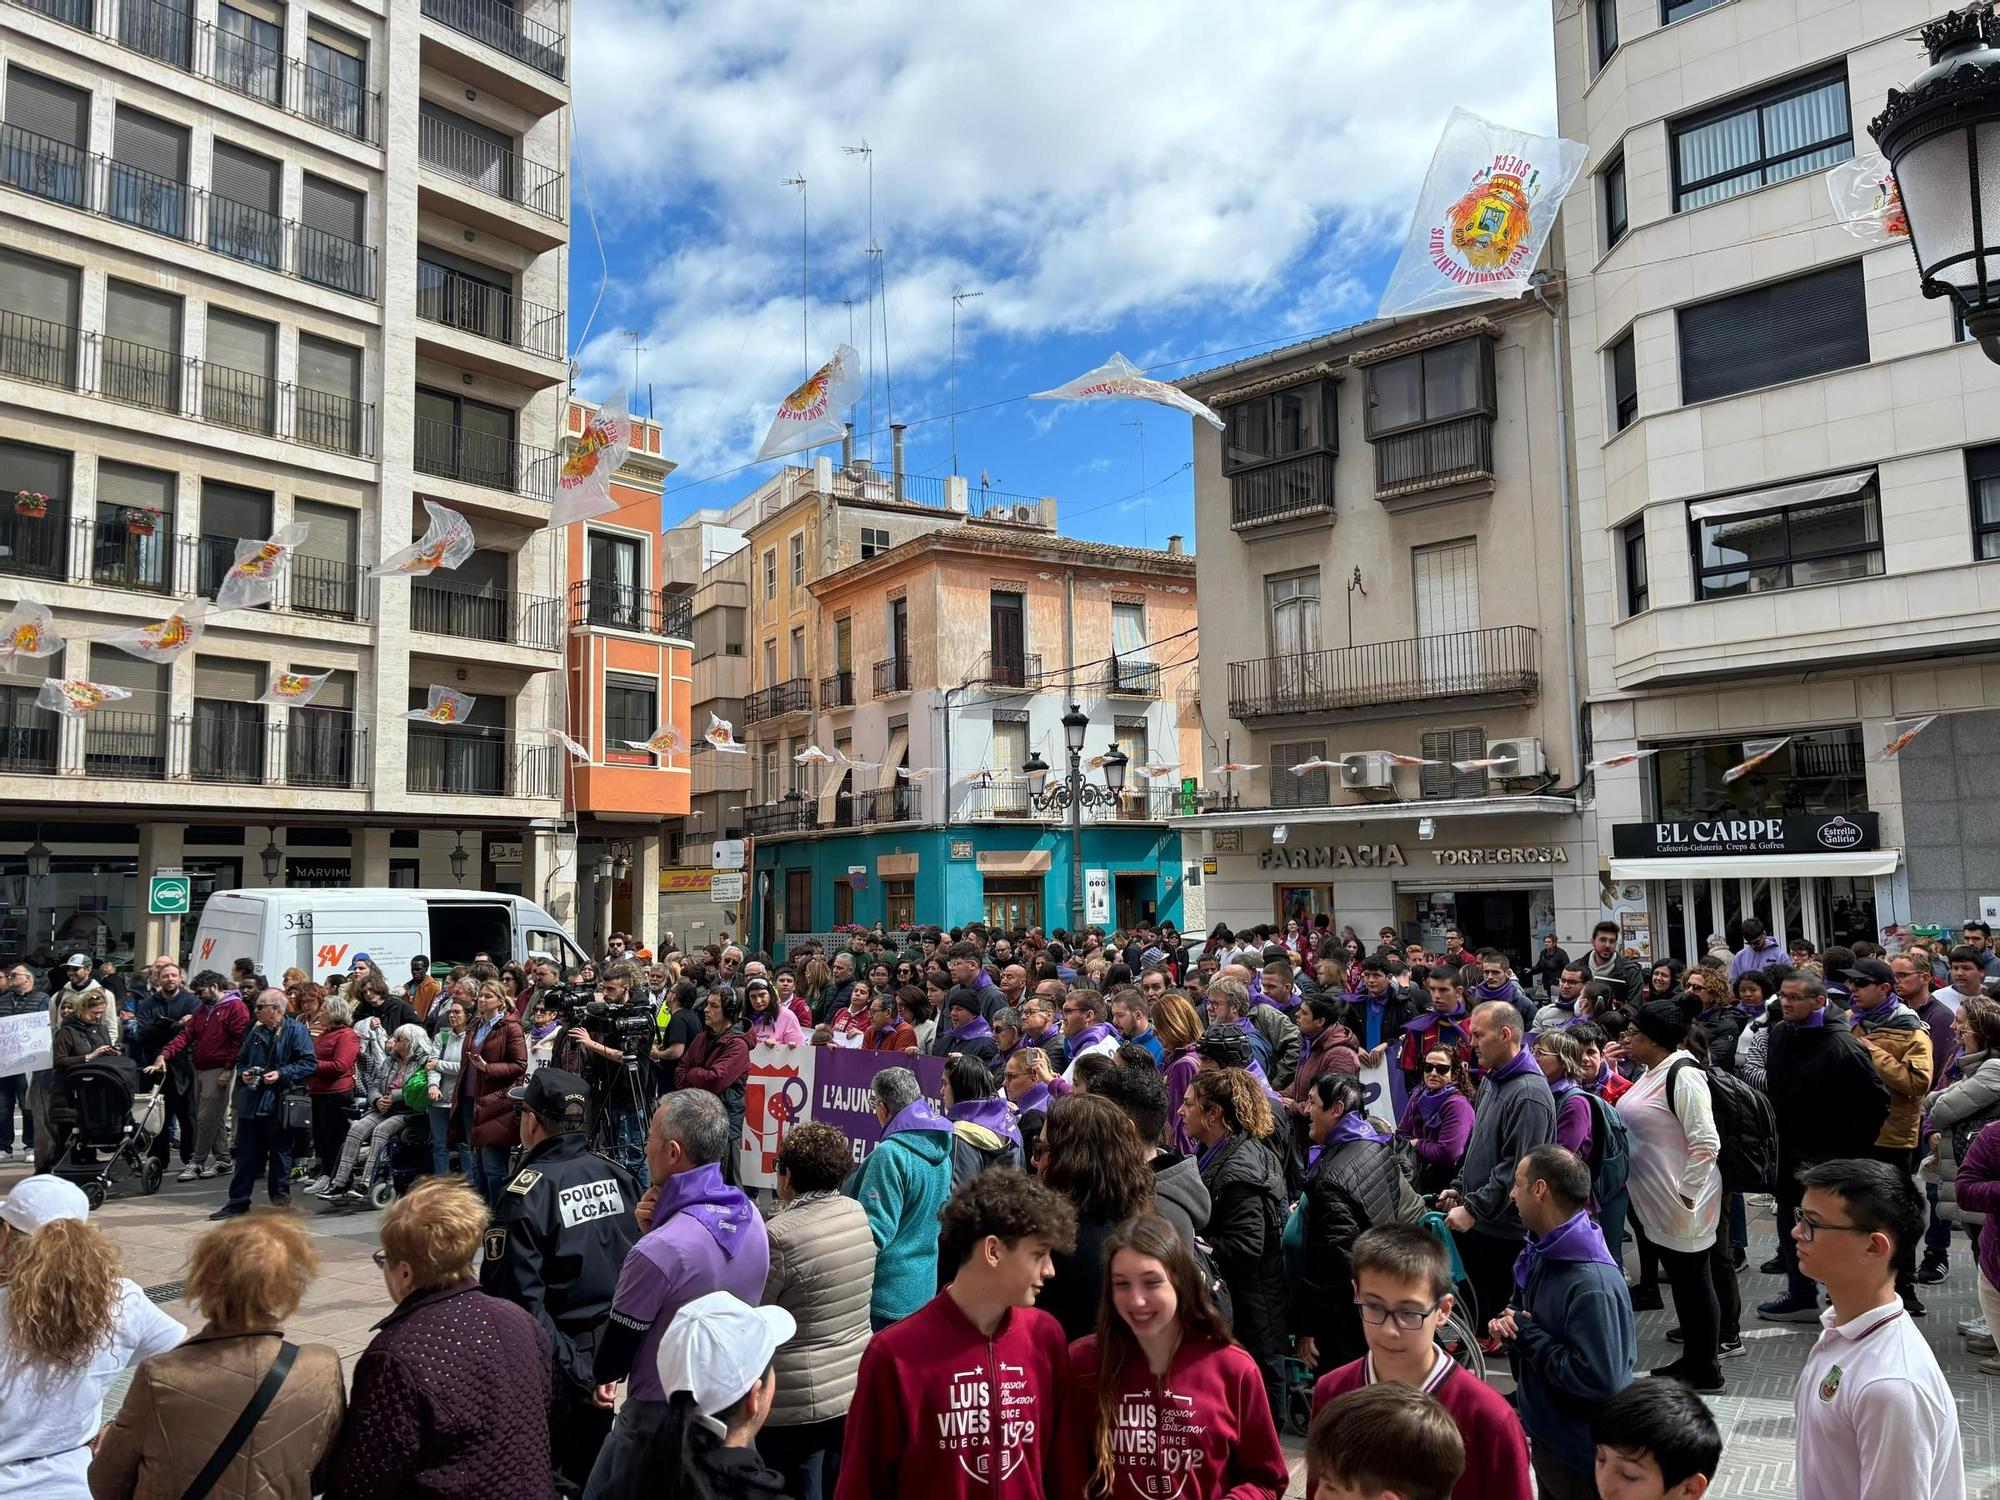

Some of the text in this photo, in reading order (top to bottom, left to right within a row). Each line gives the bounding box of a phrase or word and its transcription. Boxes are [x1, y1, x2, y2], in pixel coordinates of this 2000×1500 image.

[1492, 154, 1532, 178] SUECA
[1656, 819, 1784, 843] EL CARPE
[1823, 827, 1856, 836] Estrella
[1825, 834, 1855, 844] Galicia
[1258, 844, 1407, 869] FARMACIA
[1432, 847, 1568, 865] TORREGROSA
[1657, 841, 1785, 853] Cafeteria-Gelateria Creps & Gofres
[670, 875, 710, 888] DH
[284, 913, 313, 930] 343
[560, 1183, 618, 1206] POLICIA
[572, 1200, 617, 1222] LOCAL
[950, 1381, 990, 1409] LUIS
[937, 1408, 990, 1437] VIVES
[1120, 1404, 1157, 1428] LUIS
[1160, 1408, 1197, 1418] PASSION
[939, 1435, 991, 1449] SUECA
[1109, 1429, 1157, 1454] VIVES
[1160, 1435, 1187, 1446] SINCE
[1111, 1454, 1157, 1466] SUECA
[1160, 1447, 1204, 1474] 1972
